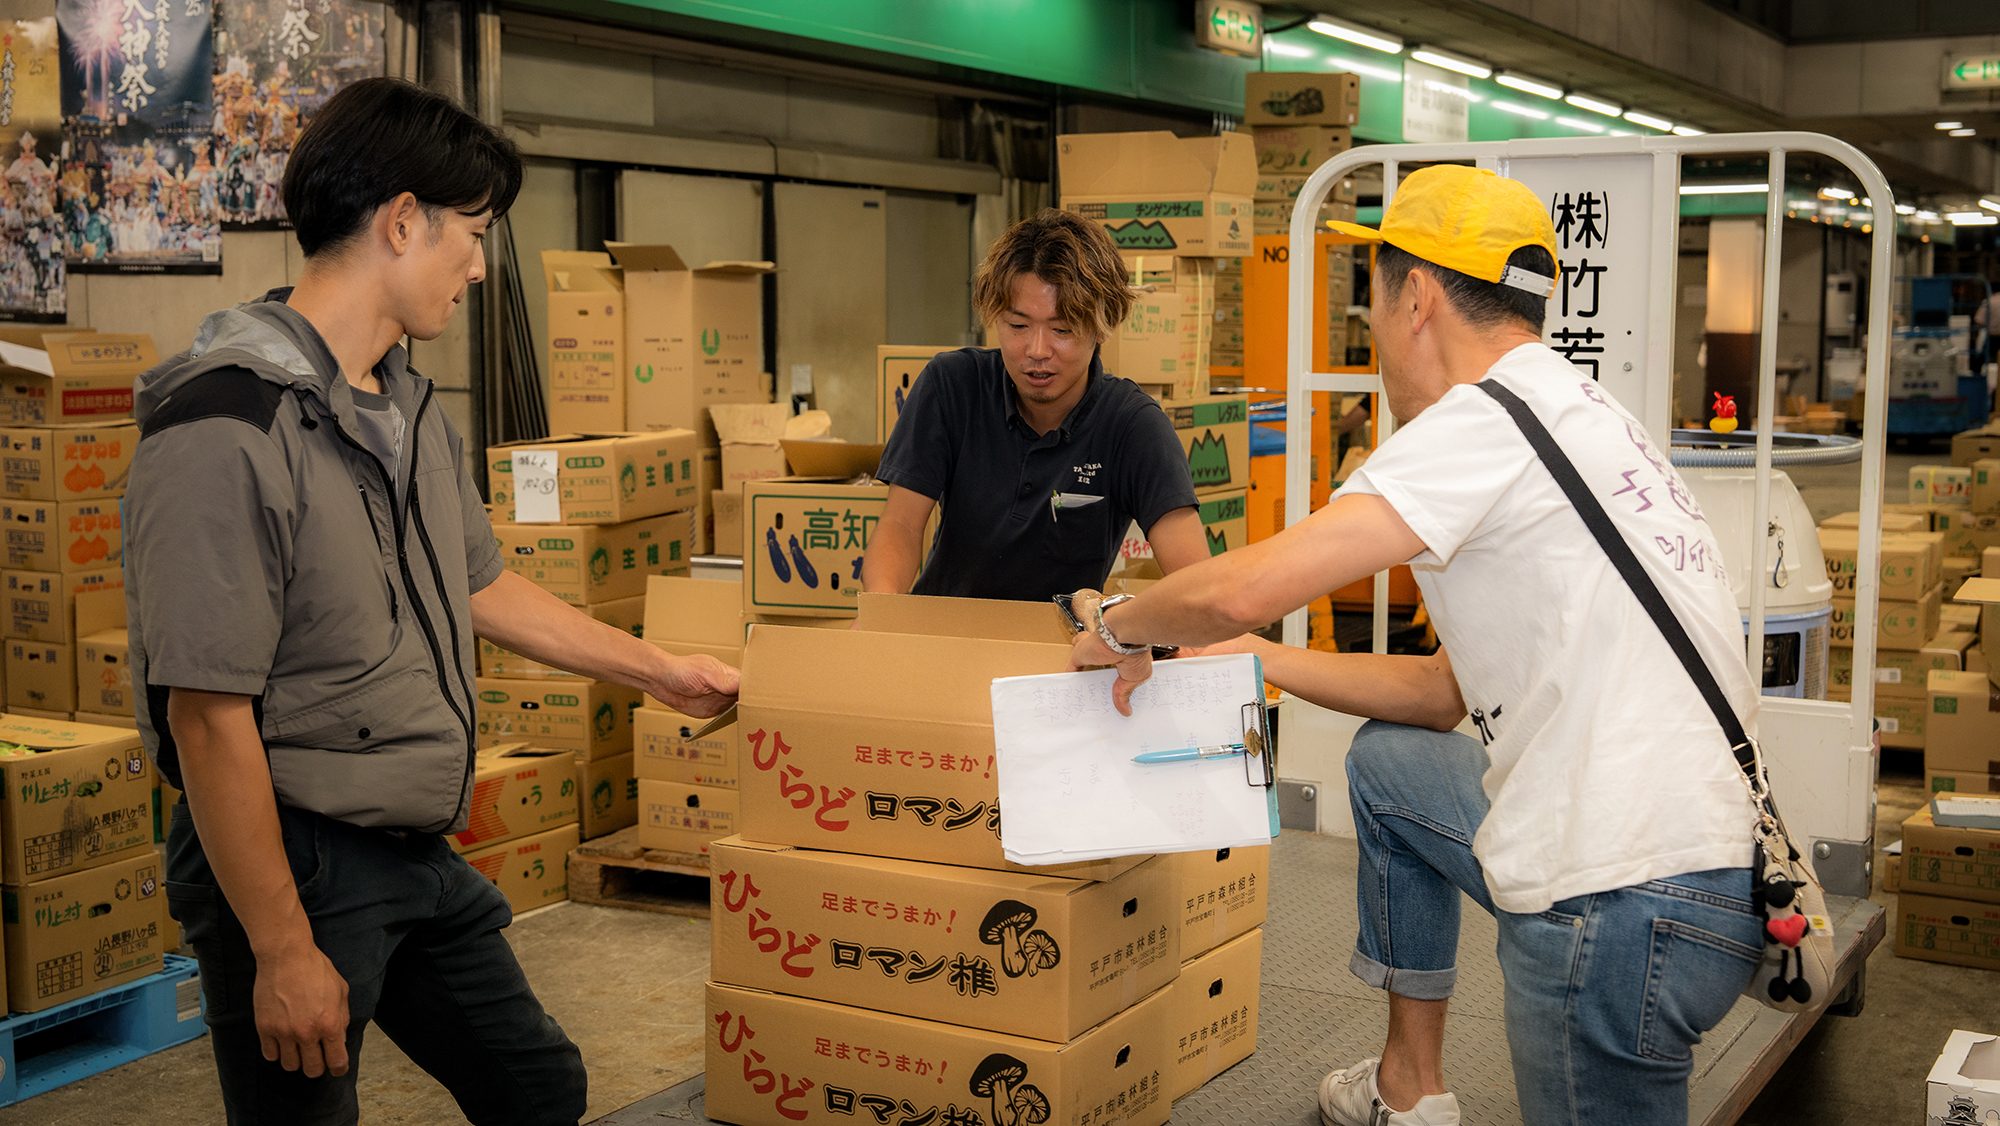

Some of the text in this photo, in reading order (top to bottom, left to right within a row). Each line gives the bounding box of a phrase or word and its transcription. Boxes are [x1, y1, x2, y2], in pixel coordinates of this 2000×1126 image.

[747, 728, 856, 832] ひらど
[855, 745, 994, 779] 足までうまか!
[22, 778, 71, 804] 川上村
[34, 901, 82, 928] 川上村
[821, 891, 957, 934] 足までうまか!
[1186, 873, 1255, 914] 平戸市森林組合
[718, 869, 821, 978] ひらど
[830, 938, 999, 998] ロマン椎
[1090, 924, 1168, 977] 平戸市森林組合
[1178, 1005, 1249, 1053] 平戸市森林組合
[715, 1011, 815, 1121] ひらど
[814, 1036, 947, 1085] 足までうまか!
